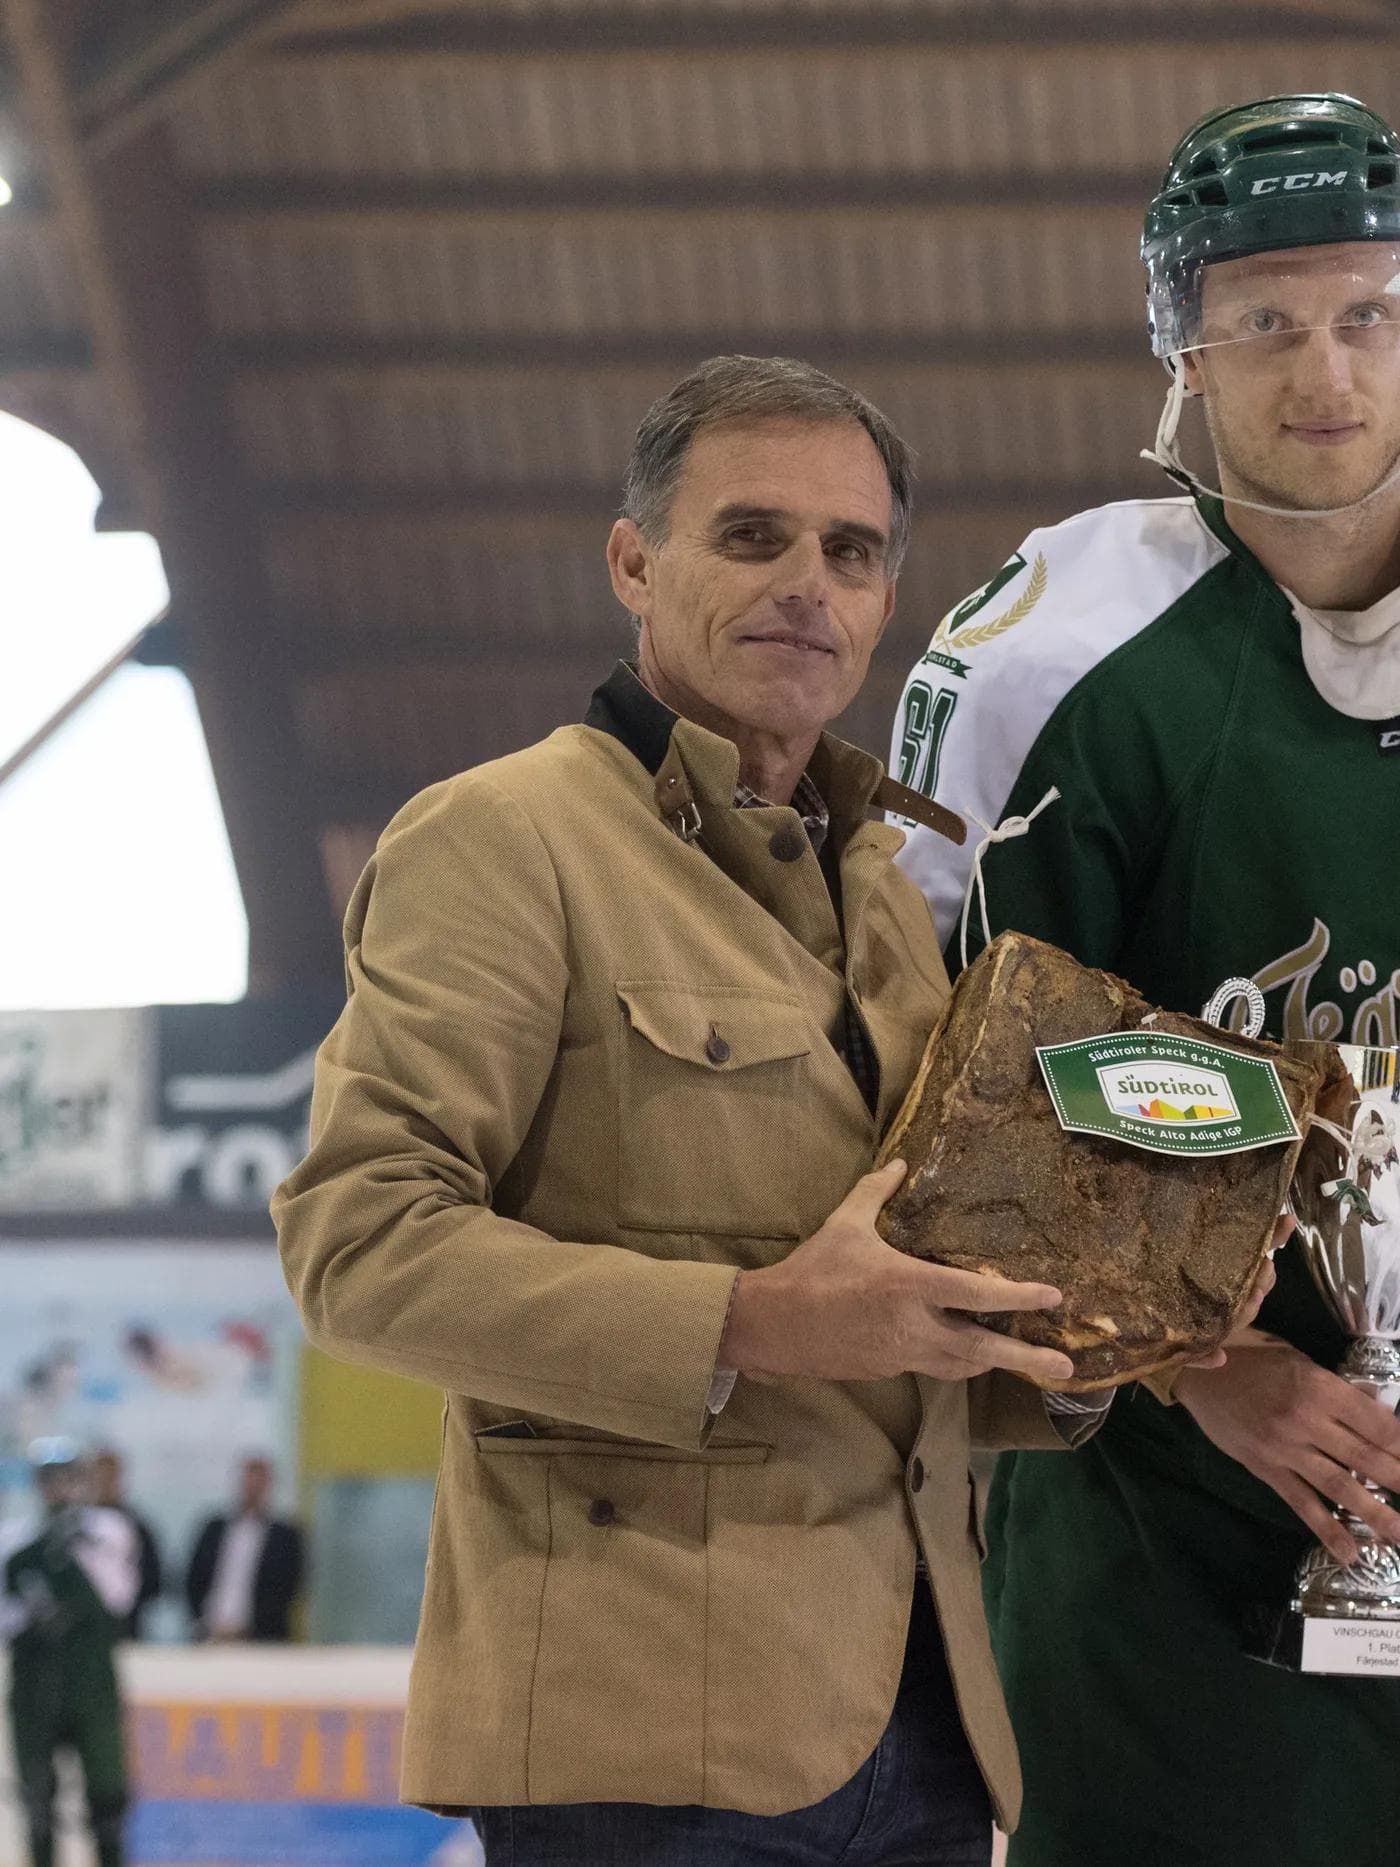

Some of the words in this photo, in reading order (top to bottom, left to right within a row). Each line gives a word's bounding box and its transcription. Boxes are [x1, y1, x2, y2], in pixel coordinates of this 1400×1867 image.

[1250, 170, 1348, 196] CCM
[1088, 1045, 1147, 1063] Südtiroler
[1151, 1045, 1187, 1059] Speck
[1191, 1051, 1226, 1069] g.g.A.
[1119, 1119, 1156, 1138] Speck
[1159, 1129, 1186, 1141] Alto
[1190, 1129, 1223, 1142] Adige
[1224, 1125, 1243, 1138] IGP
[1333, 1626, 1394, 1639] VINSCHGAU
